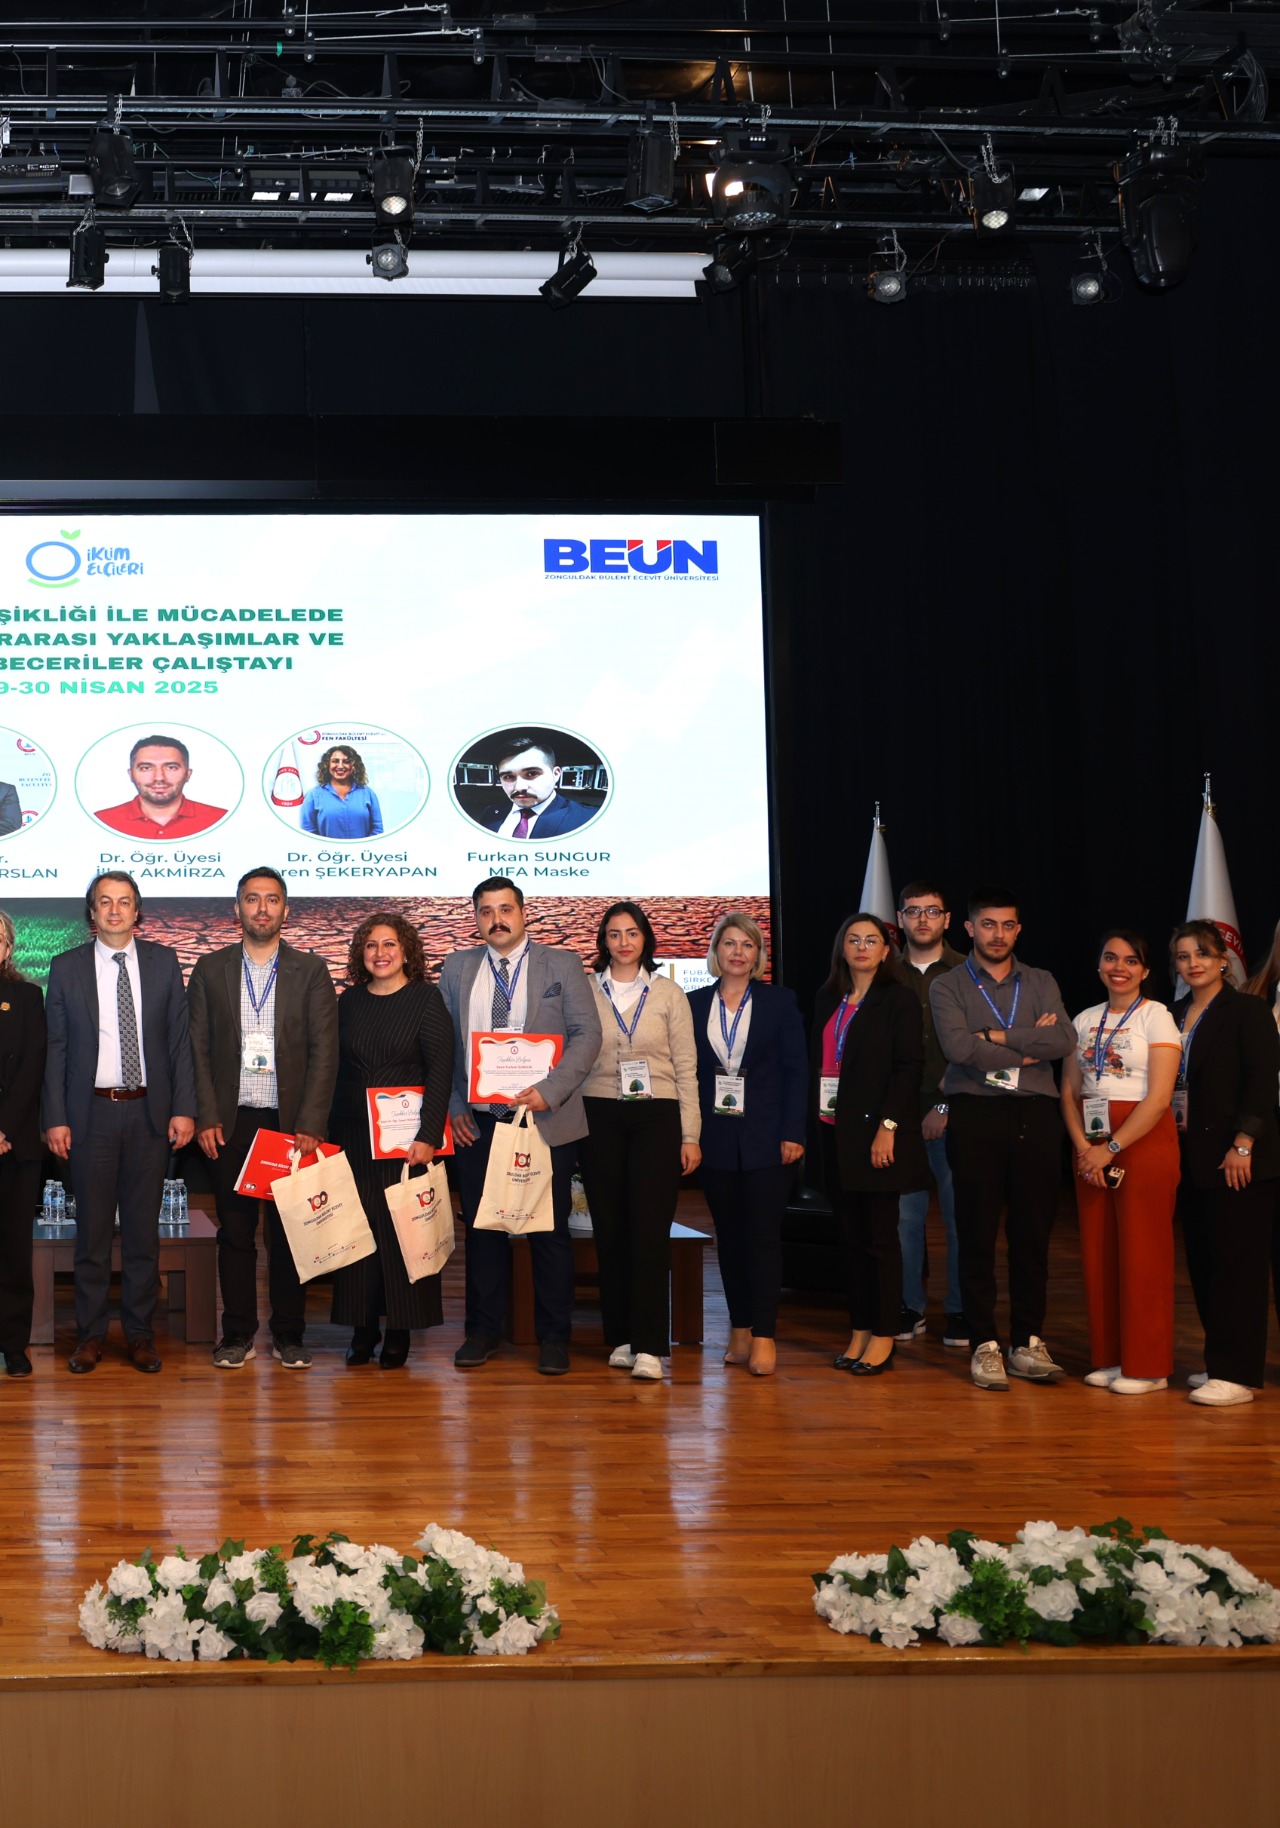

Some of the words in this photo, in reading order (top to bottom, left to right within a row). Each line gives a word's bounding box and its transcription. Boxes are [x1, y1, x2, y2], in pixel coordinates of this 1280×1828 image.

[664, 574, 719, 582] ÜNİVERSİTESİ
[106, 605, 148, 622] İLE
[157, 605, 344, 622] MÜCADELEDE
[106, 632, 300, 649] YAKLAŞIMLAR
[308, 632, 344, 646] VE
[152, 656, 293, 673] ÇALIŞTAYI
[59, 677, 145, 694] NİSAN
[154, 680, 219, 694] 2025
[100, 853, 123, 863] Dr.
[130, 851, 168, 865] Öğr.
[173, 851, 221, 865] Üyesi
[287, 852, 312, 863] Dr.
[318, 850, 355, 865] Öğr.
[361, 850, 408, 865] Üyesi
[468, 852, 529, 862] Furkan
[534, 852, 611, 863] SUNGUR
[140, 865, 225, 878] AKMİRZA
[315, 867, 438, 880] ŞEKERYAPAN
[489, 867, 529, 877] MFA
[534, 866, 591, 877] Maske
